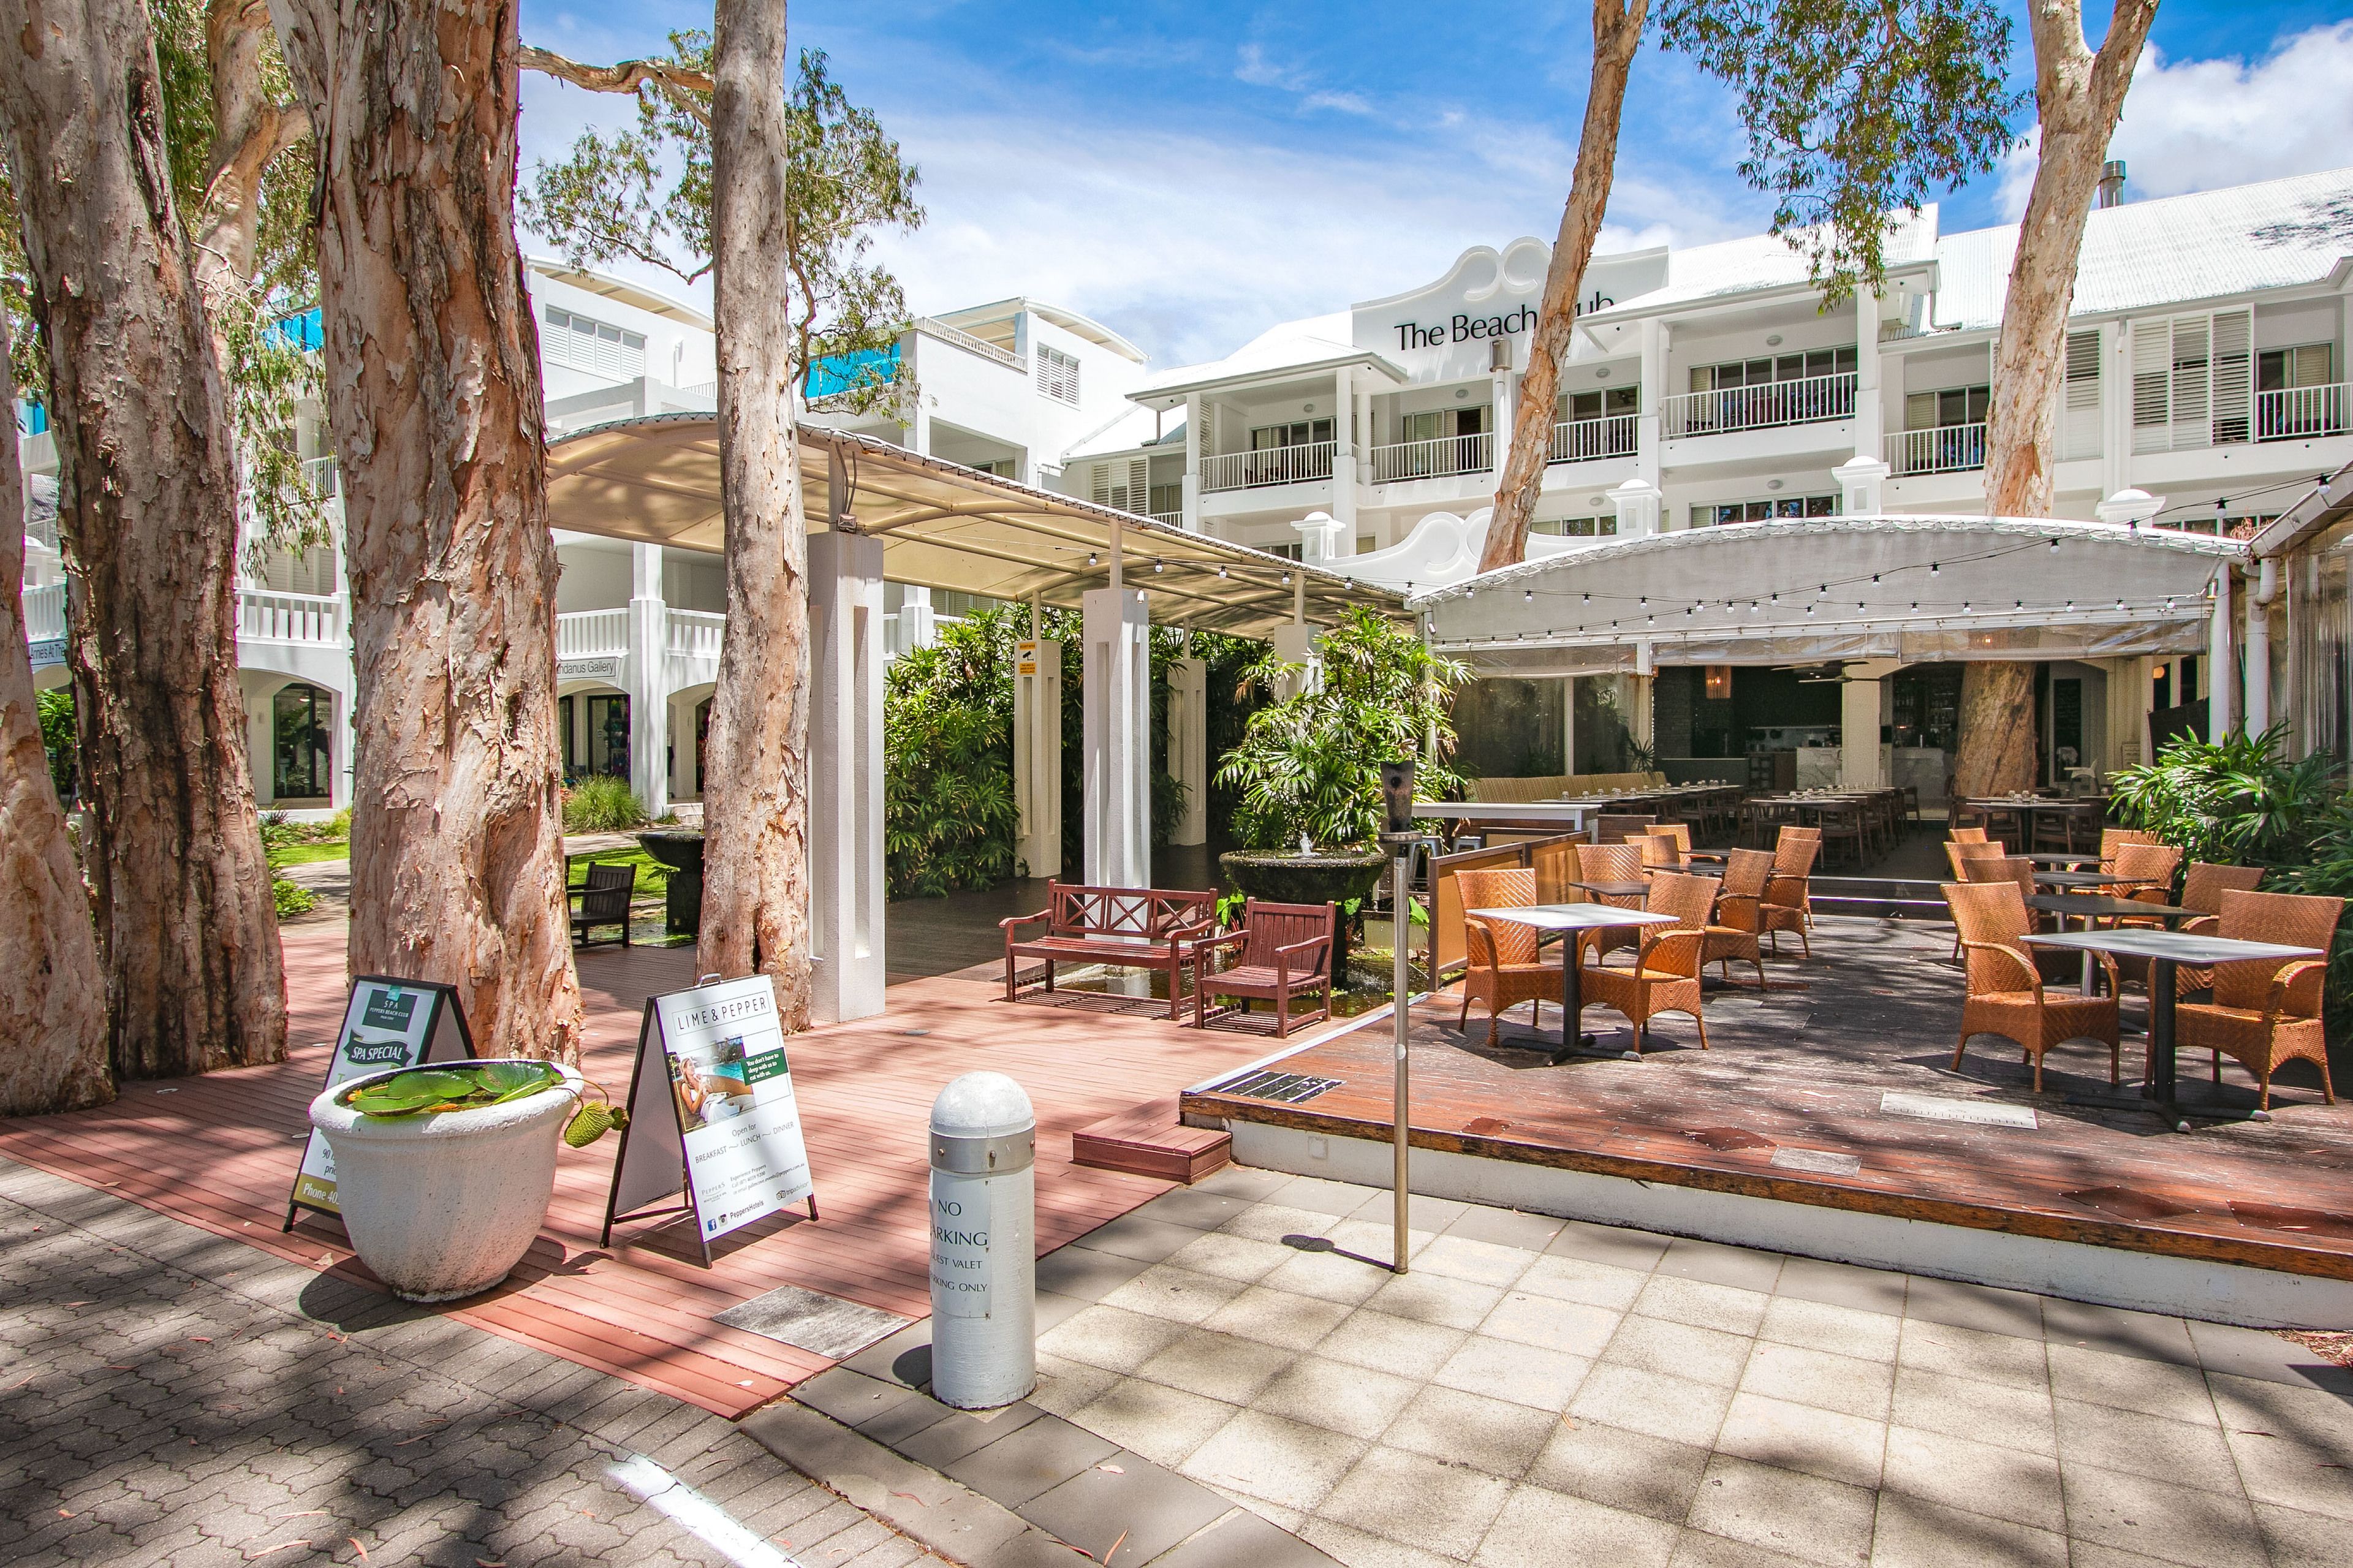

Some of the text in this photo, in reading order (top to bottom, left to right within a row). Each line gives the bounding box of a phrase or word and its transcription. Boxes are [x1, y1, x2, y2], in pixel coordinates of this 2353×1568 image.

[1394, 291, 1614, 350] The Beach ub
[557, 661, 613, 675] ndanus Gallery
[384, 1000, 399, 1009] SPA
[678, 997, 767, 1030] LIME & PEPPER
[351, 1046, 403, 1061] SPA SPECIAL
[732, 1128, 748, 1137] Open
[695, 1121, 794, 1164] BREAKFAST LUNCH DINNER
[322, 1148, 331, 1159] 90
[324, 1165, 336, 1176] pric
[303, 1183, 339, 1205] Phone 40
[730, 1200, 764, 1219] PeppersHotels
[938, 1199, 962, 1216] NO
[930, 1224, 988, 1246] ARKING
[952, 1259, 983, 1269] VALET
[959, 1283, 988, 1292] ONLY
